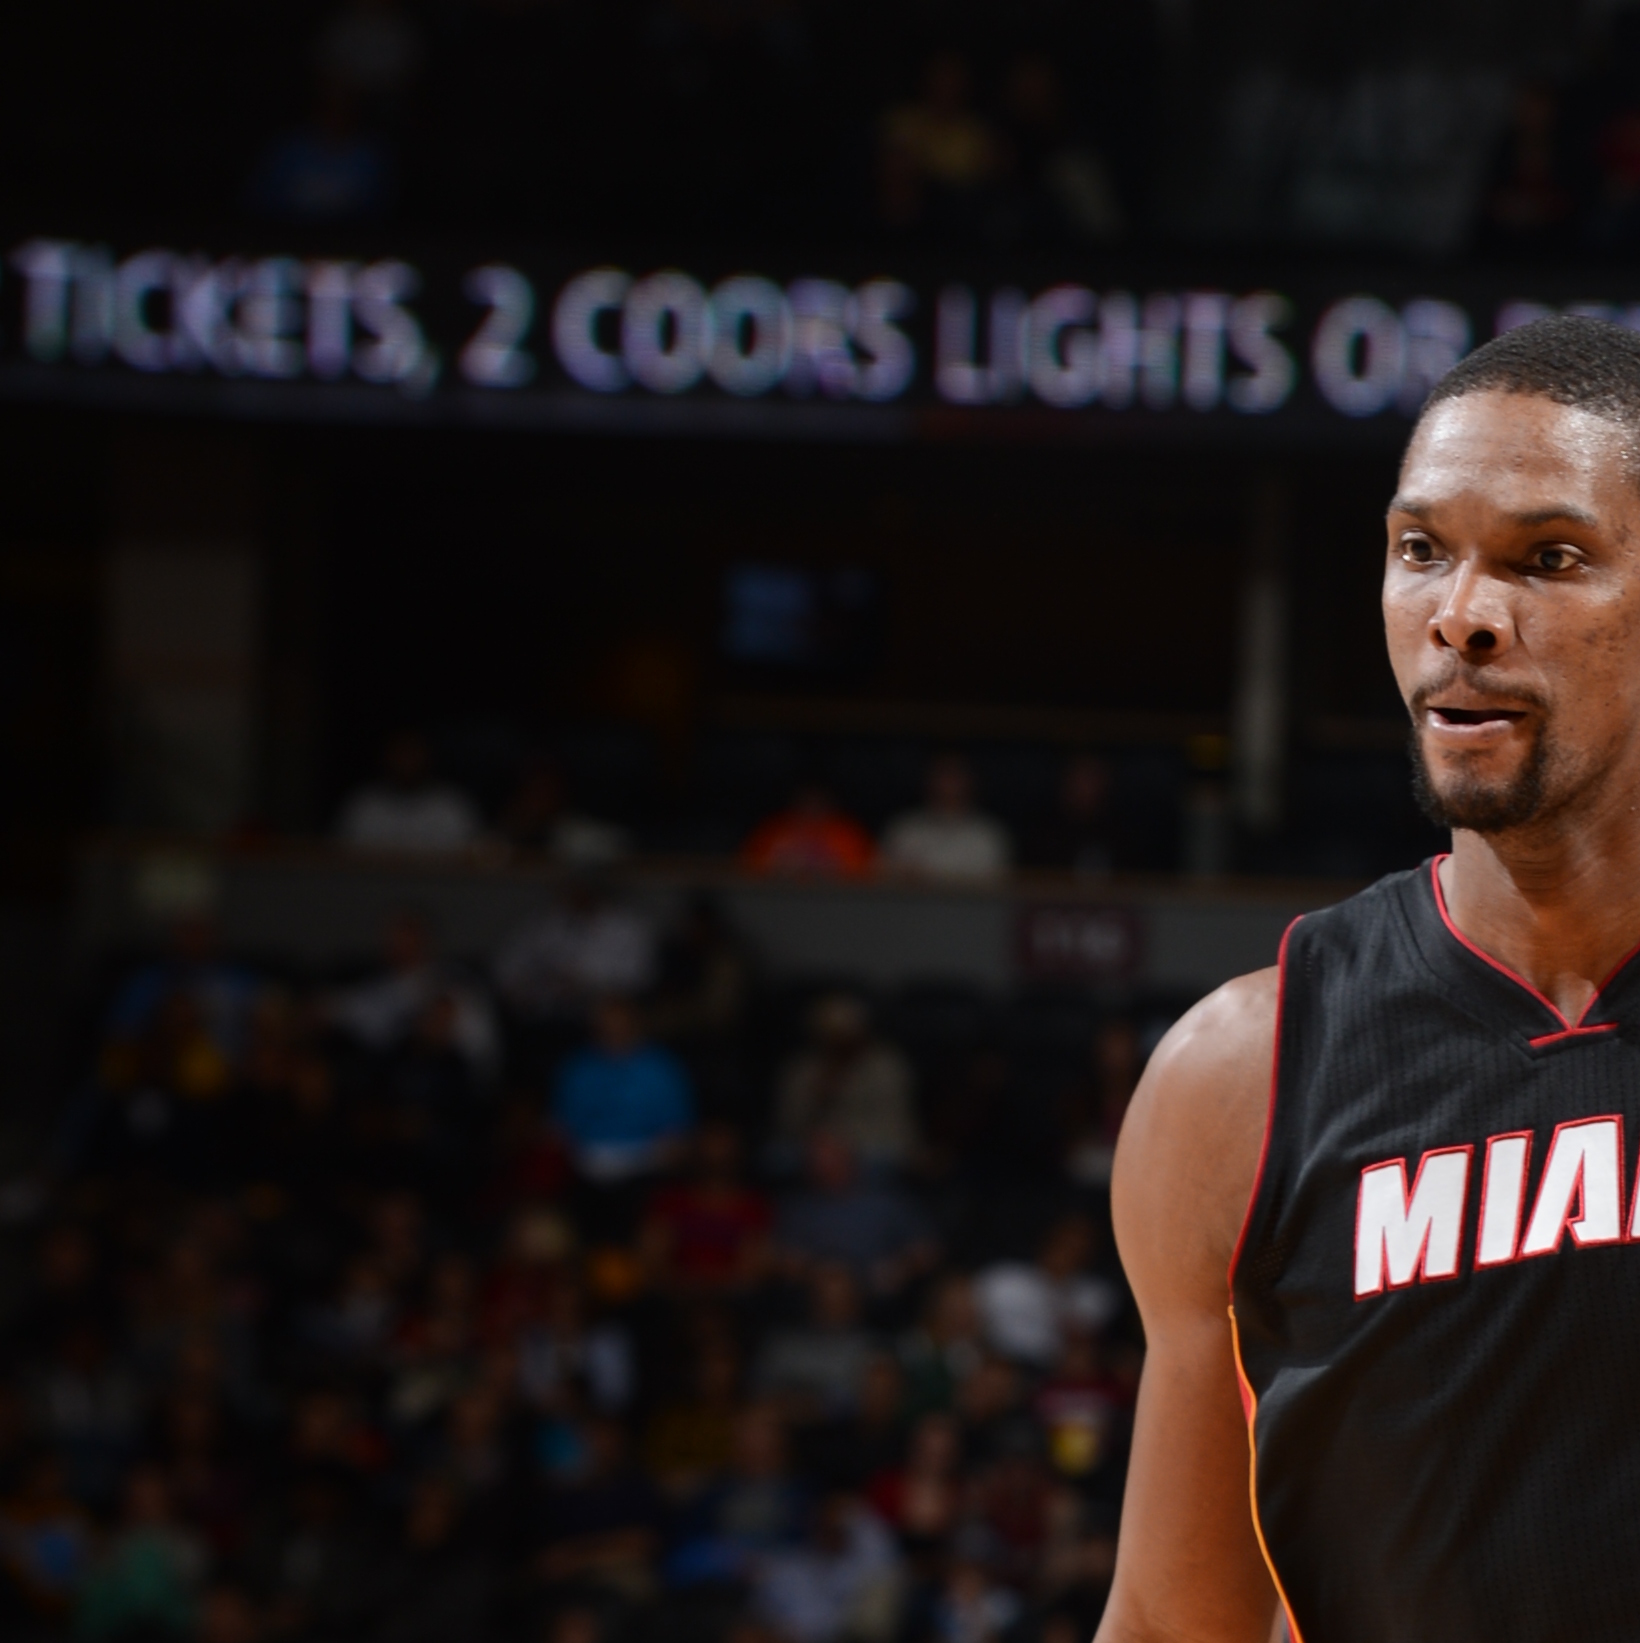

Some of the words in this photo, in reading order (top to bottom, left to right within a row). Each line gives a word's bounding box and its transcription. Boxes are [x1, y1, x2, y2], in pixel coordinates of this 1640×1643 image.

[14, 240, 438, 393] TICKETS,
[463, 264, 535, 387] 2
[553, 269, 914, 400] COORS
[935, 284, 1295, 413] LIGHTS
